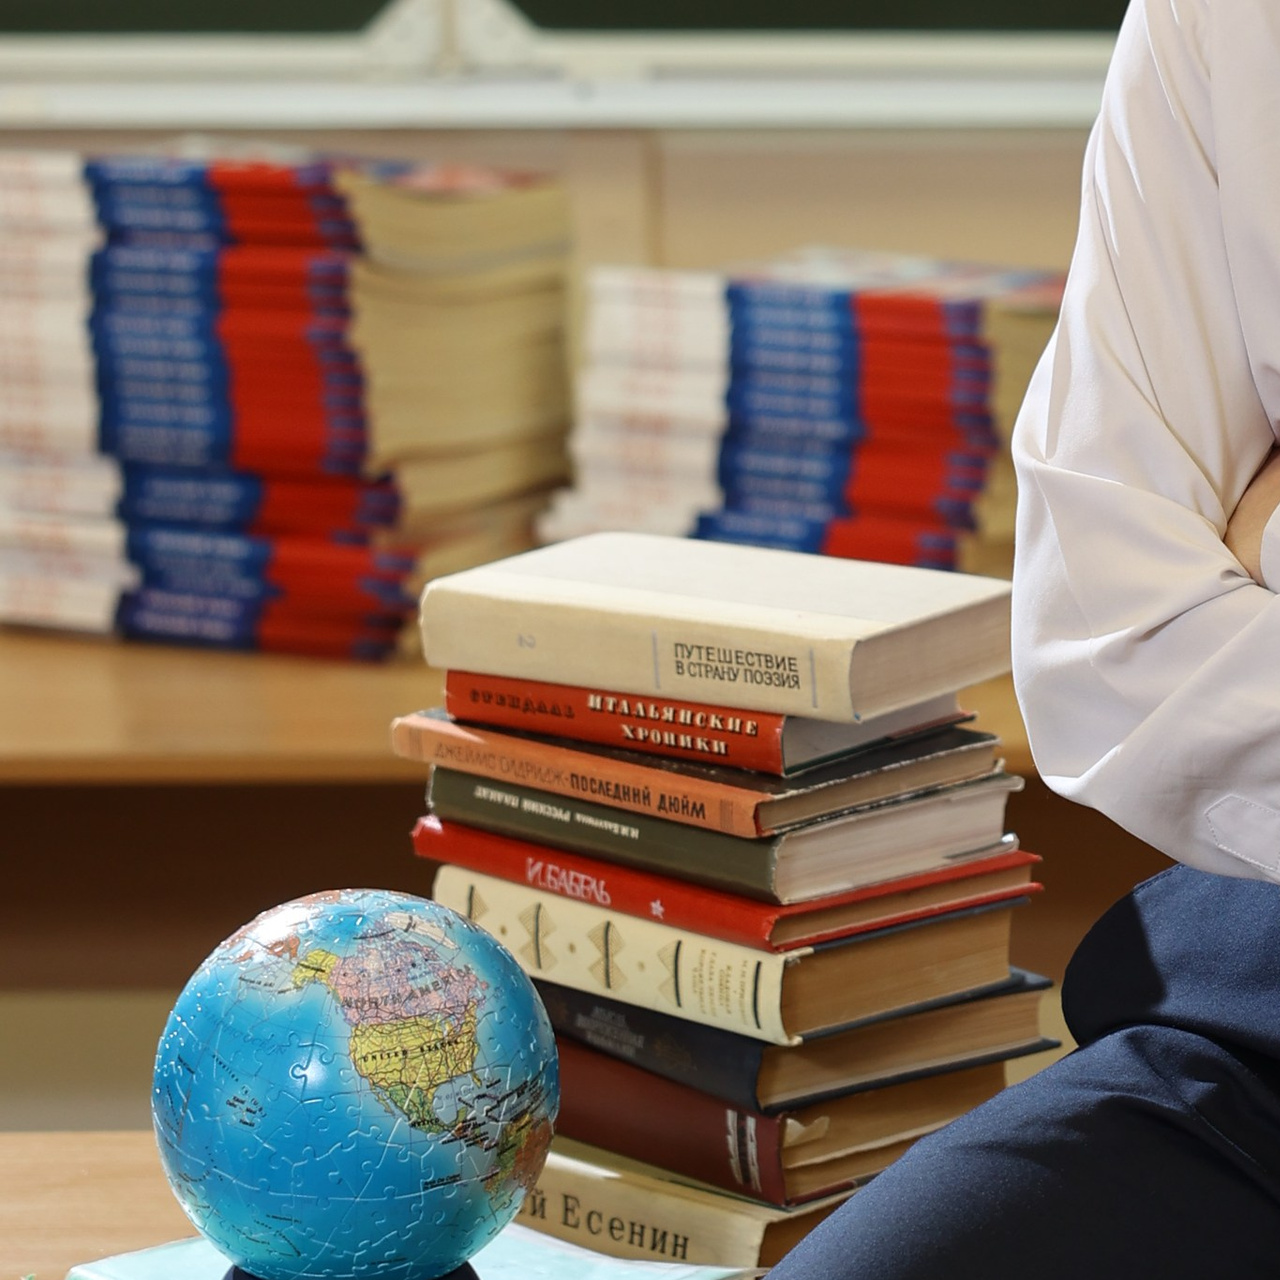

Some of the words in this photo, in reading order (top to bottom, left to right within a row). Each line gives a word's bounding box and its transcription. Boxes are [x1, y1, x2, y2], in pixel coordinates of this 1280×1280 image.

[674, 642, 799, 673] ПУТЕШЕСТВИЕ
[675, 660, 685, 676] В
[687, 661, 740, 682] СТРАНУ
[743, 668, 801, 690] ПОЭЗИЯ
[587, 693, 759, 737] ИТАЛЬЯНСКИЕ
[620, 723, 728, 755] ХРОНИКИ
[657, 793, 706, 820] ДЮЙМ
[561, 1192, 690, 1261] Есенин
